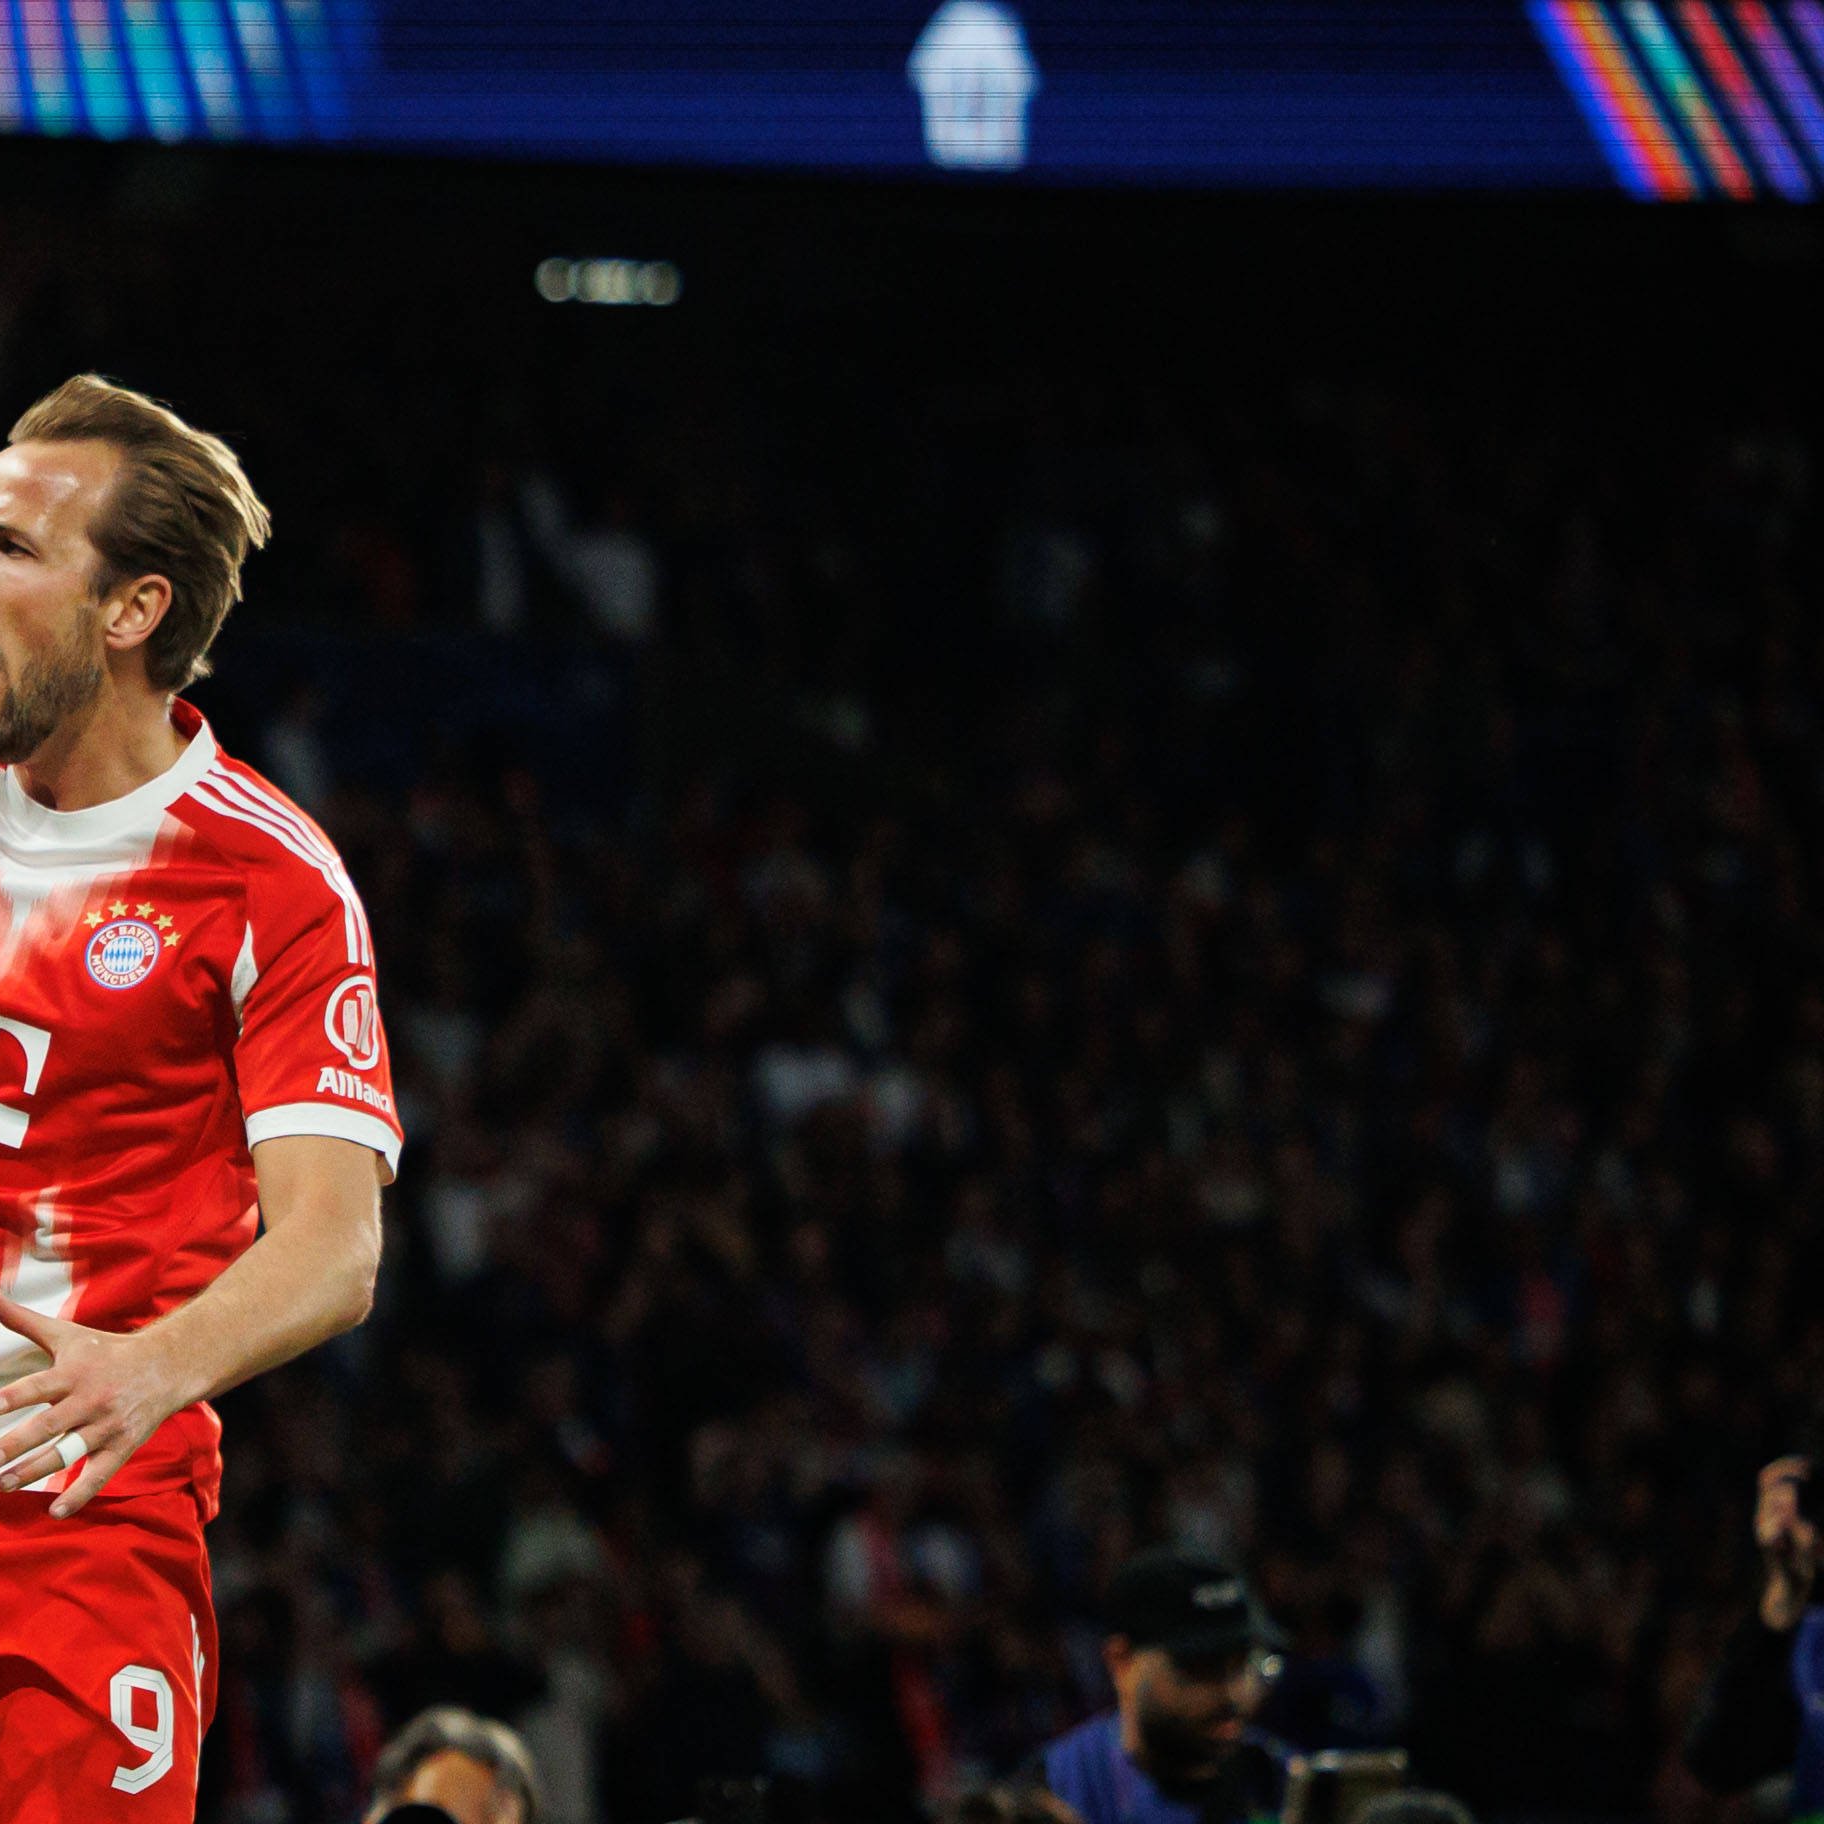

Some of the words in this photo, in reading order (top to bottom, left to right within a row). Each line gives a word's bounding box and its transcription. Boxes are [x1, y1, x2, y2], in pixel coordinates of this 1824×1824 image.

[98, 929, 117, 945] FC
[118, 925, 155, 957] BAYERN
[110, 1664, 174, 1795] 9
